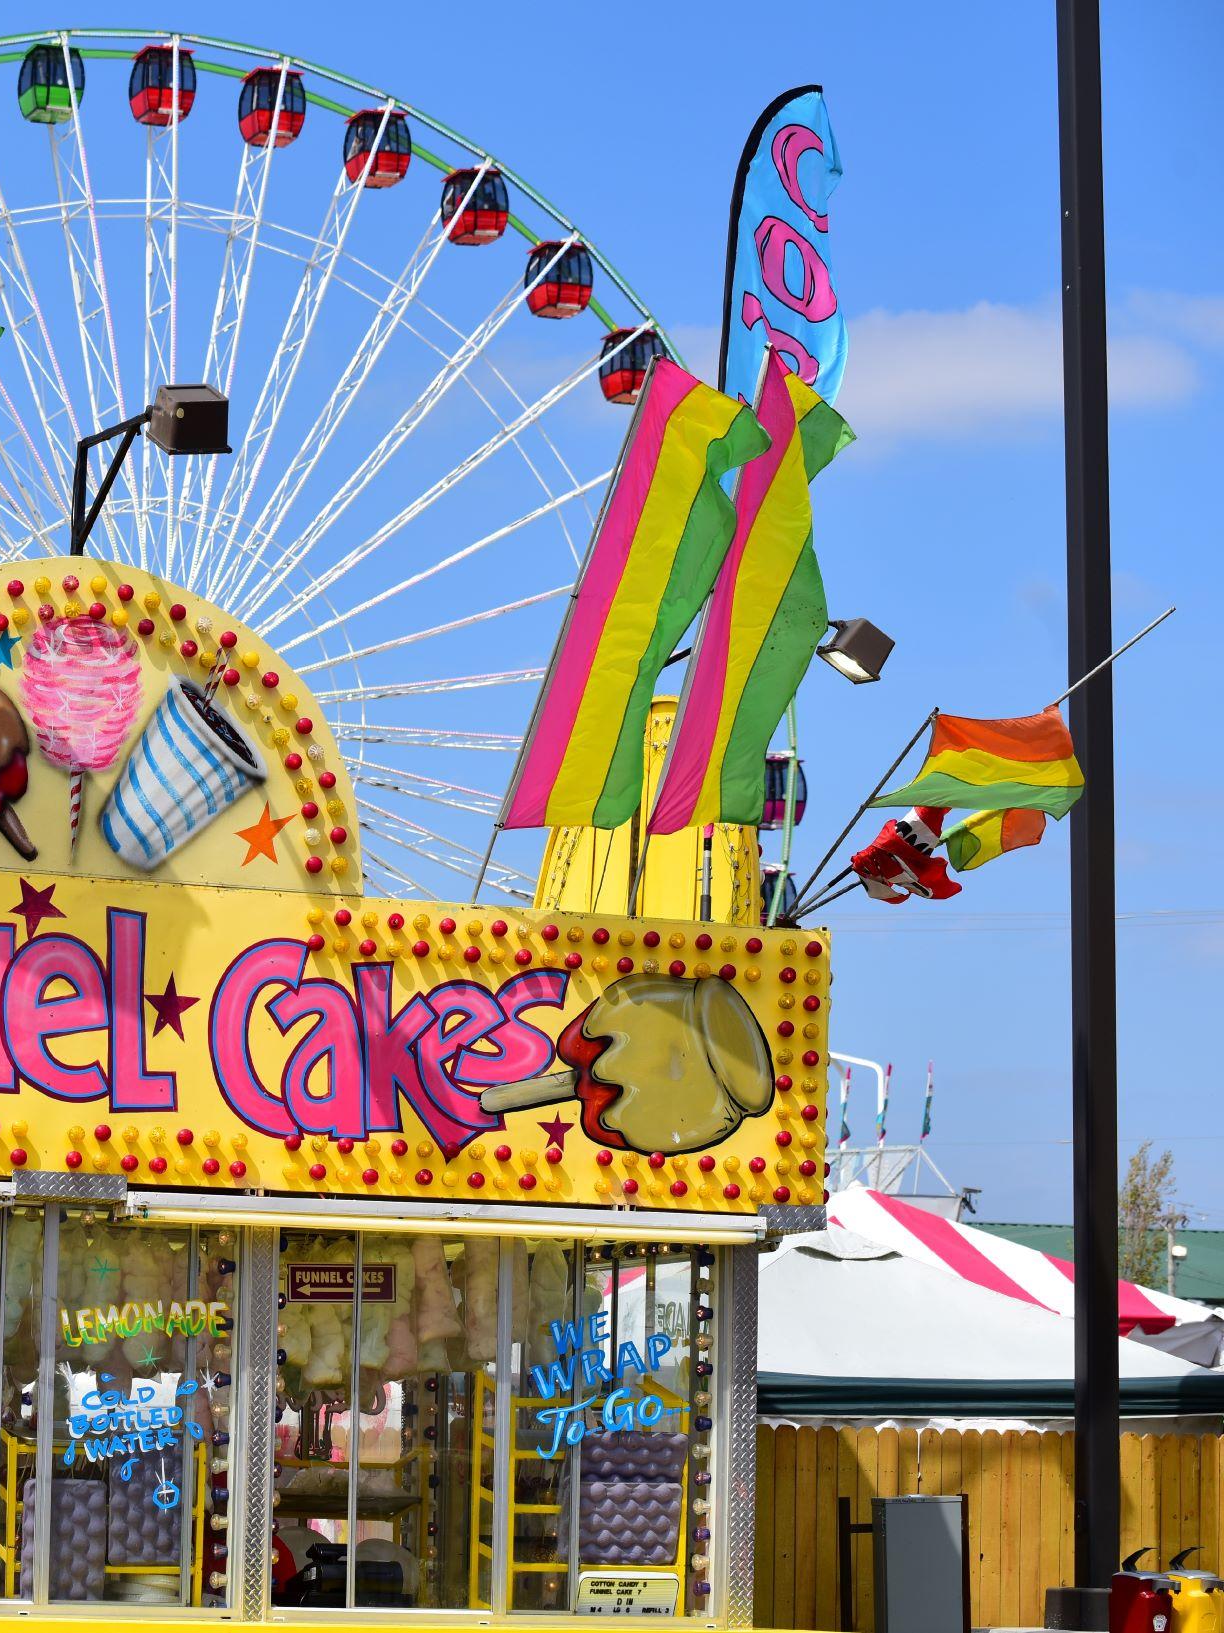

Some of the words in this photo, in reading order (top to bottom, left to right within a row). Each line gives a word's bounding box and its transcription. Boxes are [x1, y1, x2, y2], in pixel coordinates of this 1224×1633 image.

[296, 1271, 343, 1284] FUNNEL
[346, 1271, 385, 1284] CKES
[61, 1300, 230, 1348] LEMONADE
[550, 1311, 611, 1355] WE
[531, 1332, 671, 1400] WRAP
[81, 1386, 156, 1411] COLD
[66, 1406, 184, 1439] BOTTLED
[84, 1428, 178, 1463] WATER
